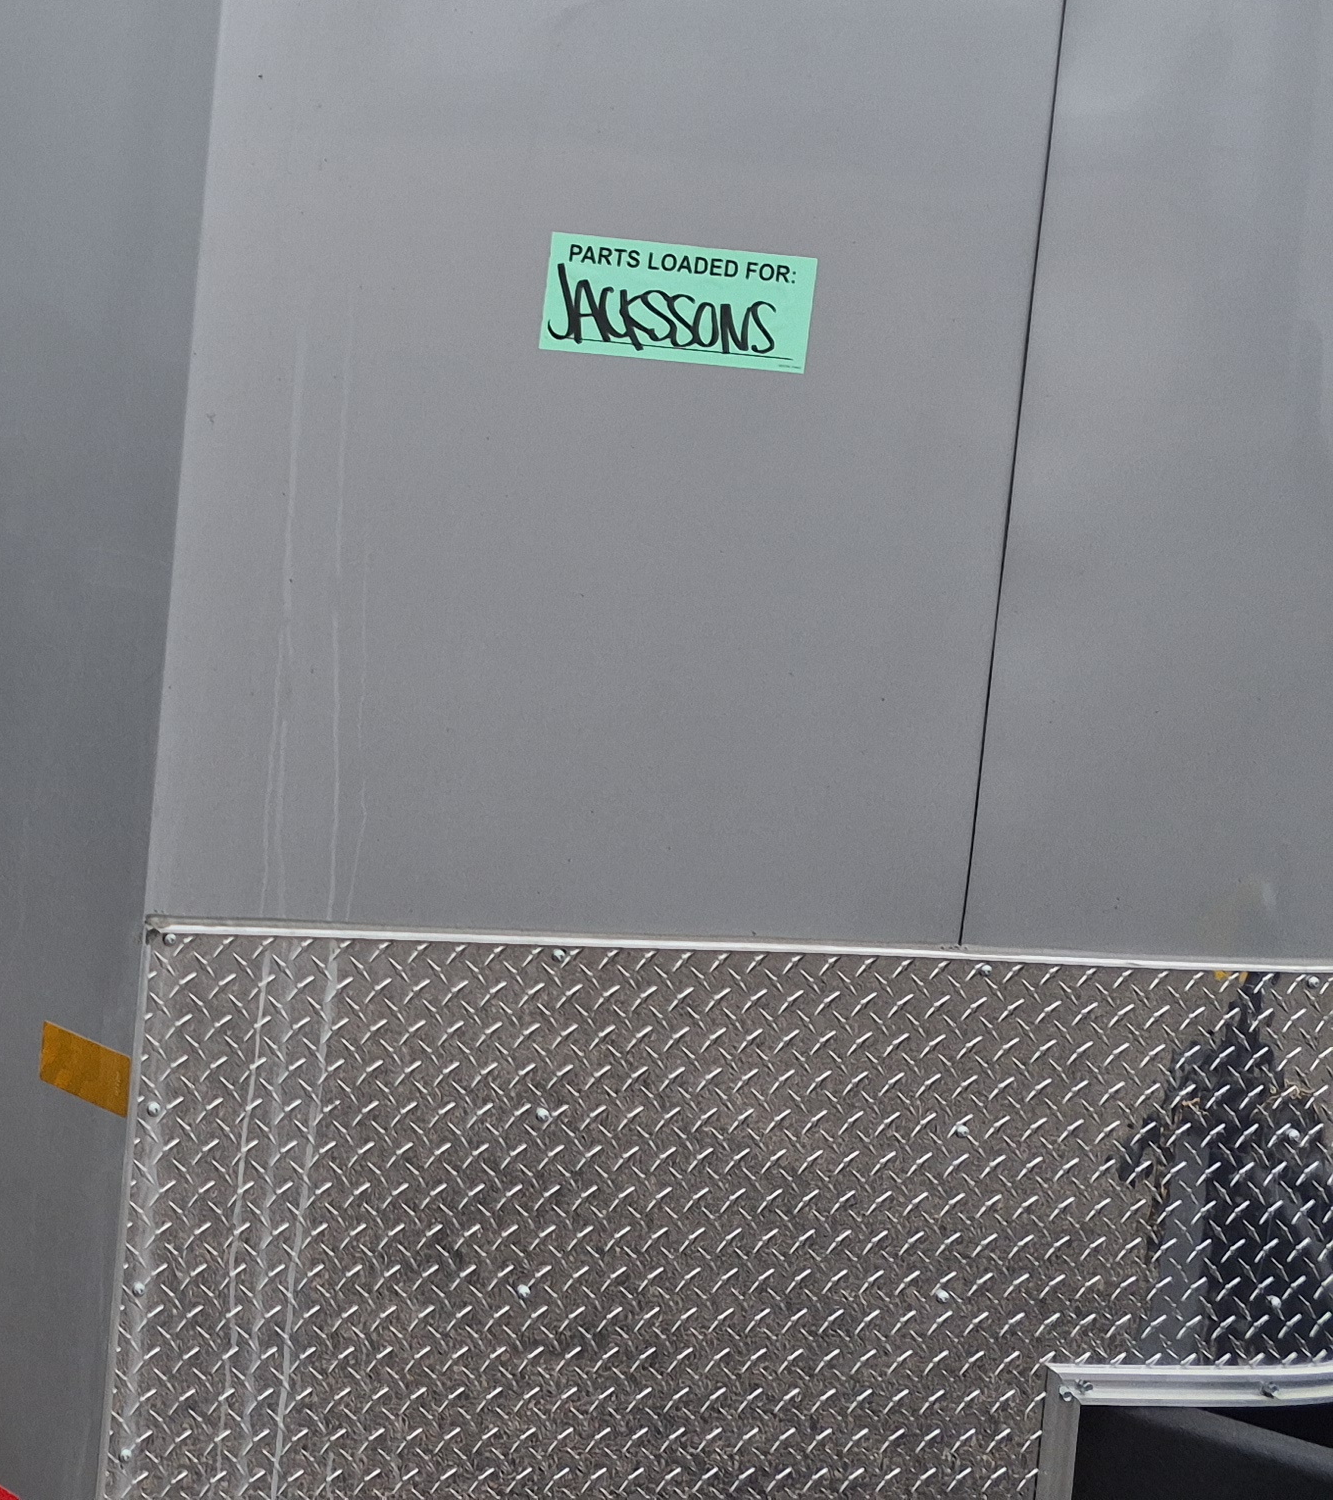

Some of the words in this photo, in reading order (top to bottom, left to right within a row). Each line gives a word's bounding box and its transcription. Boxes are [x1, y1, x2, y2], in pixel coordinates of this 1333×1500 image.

[568, 243, 641, 268] PARTS
[647, 251, 739, 279] LOADED
[745, 261, 797, 285] FOR:
